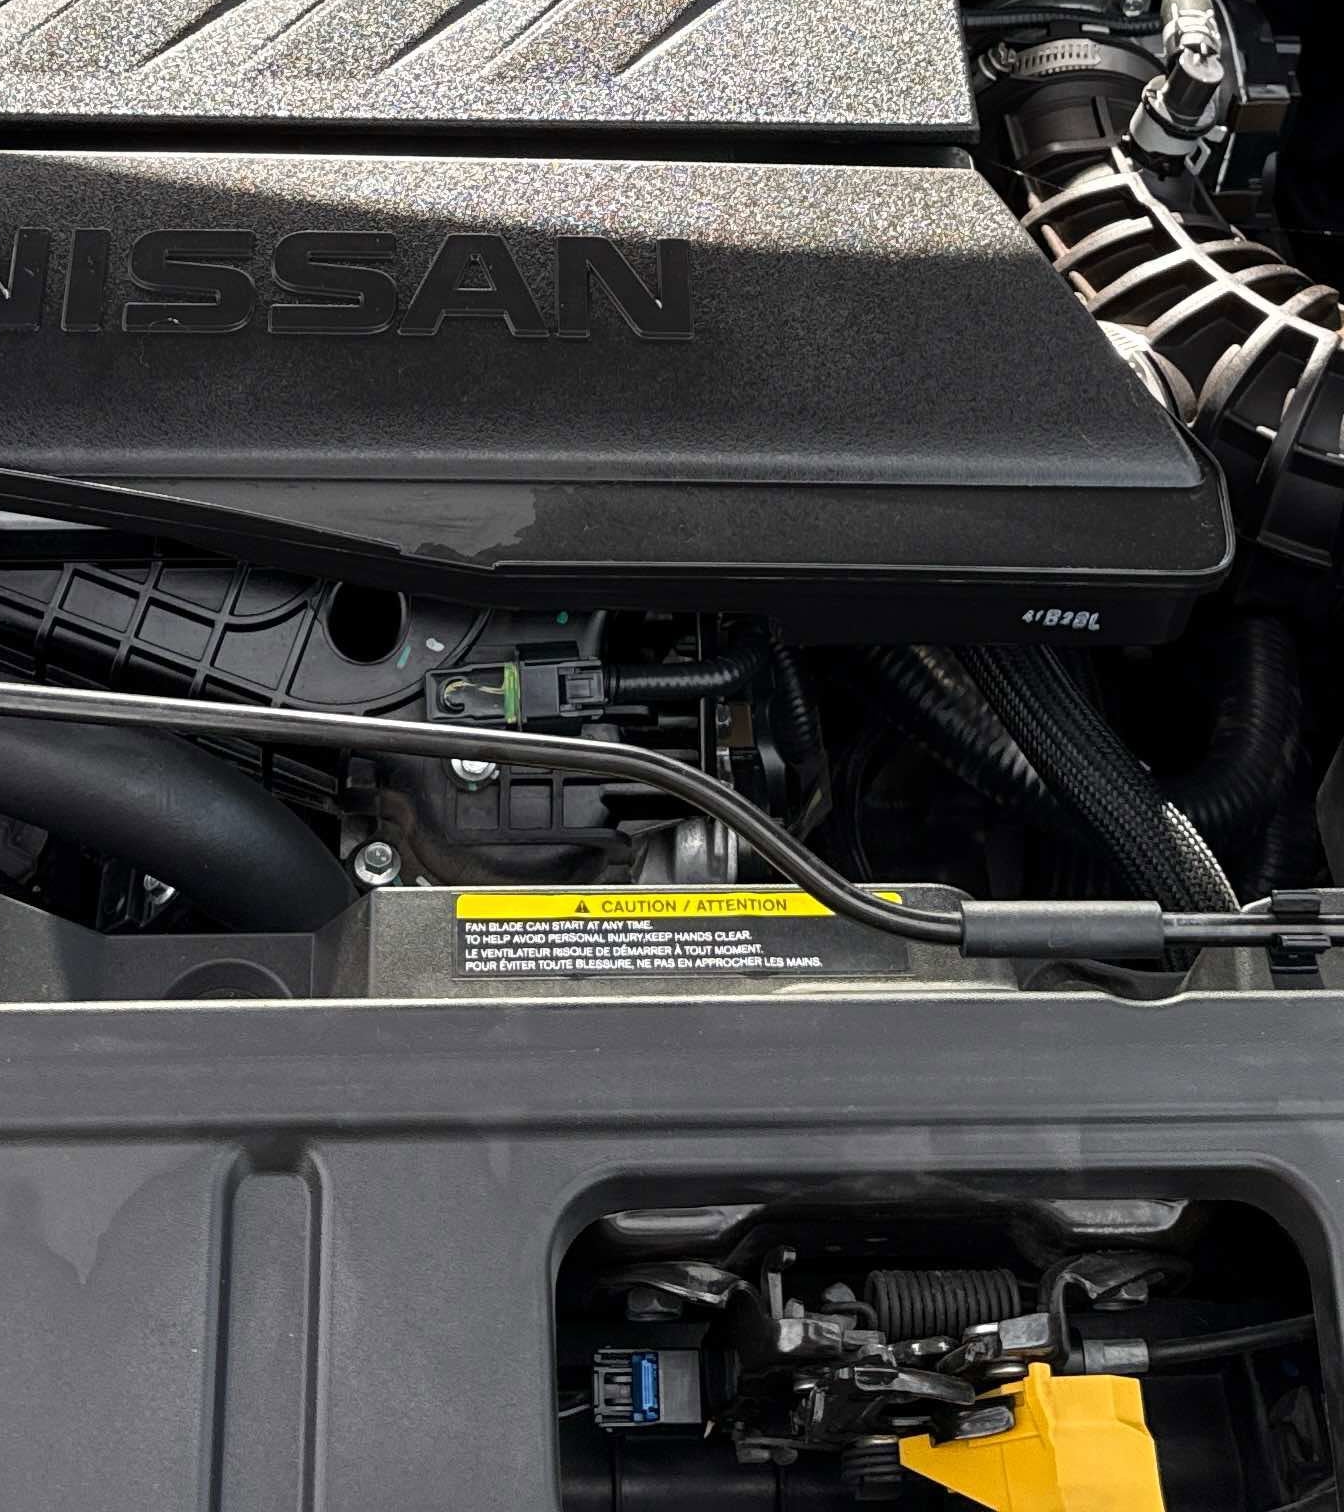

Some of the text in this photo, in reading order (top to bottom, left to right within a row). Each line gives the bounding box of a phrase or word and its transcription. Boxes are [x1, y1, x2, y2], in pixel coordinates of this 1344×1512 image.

[601, 899, 677, 914] CAUTION
[696, 897, 788, 913] ATTENTION
[465, 922, 487, 932] FAN
[488, 921, 524, 932] BLADE
[526, 921, 550, 932] CAN
[552, 920, 585, 931] START
[586, 920, 600, 931] AT
[601, 920, 624, 931] ANY
[465, 934, 481, 945] TO
[482, 934, 512, 945] HELP
[512, 933, 546, 944] AVOID
[548, 932, 606, 944] PERSONAL
[674, 930, 713, 942] HANDS
[714, 930, 752, 941] CLEAR.
[465, 943, 764, 959] LE VENTILATEUR RISQUE DE DÉMARRER À TOUT MOMENT.
[465, 960, 498, 972] POUR
[499, 958, 536, 971] ÉVITER
[538, 960, 573, 971] TOUTE
[636, 958, 652, 969] NE
[654, 958, 676, 968] PAS
[677, 957, 693, 968] EN
[694, 956, 762, 968] APPROCHER
[764, 956, 785, 967] LES
[786, 956, 823, 968] MAINS.
